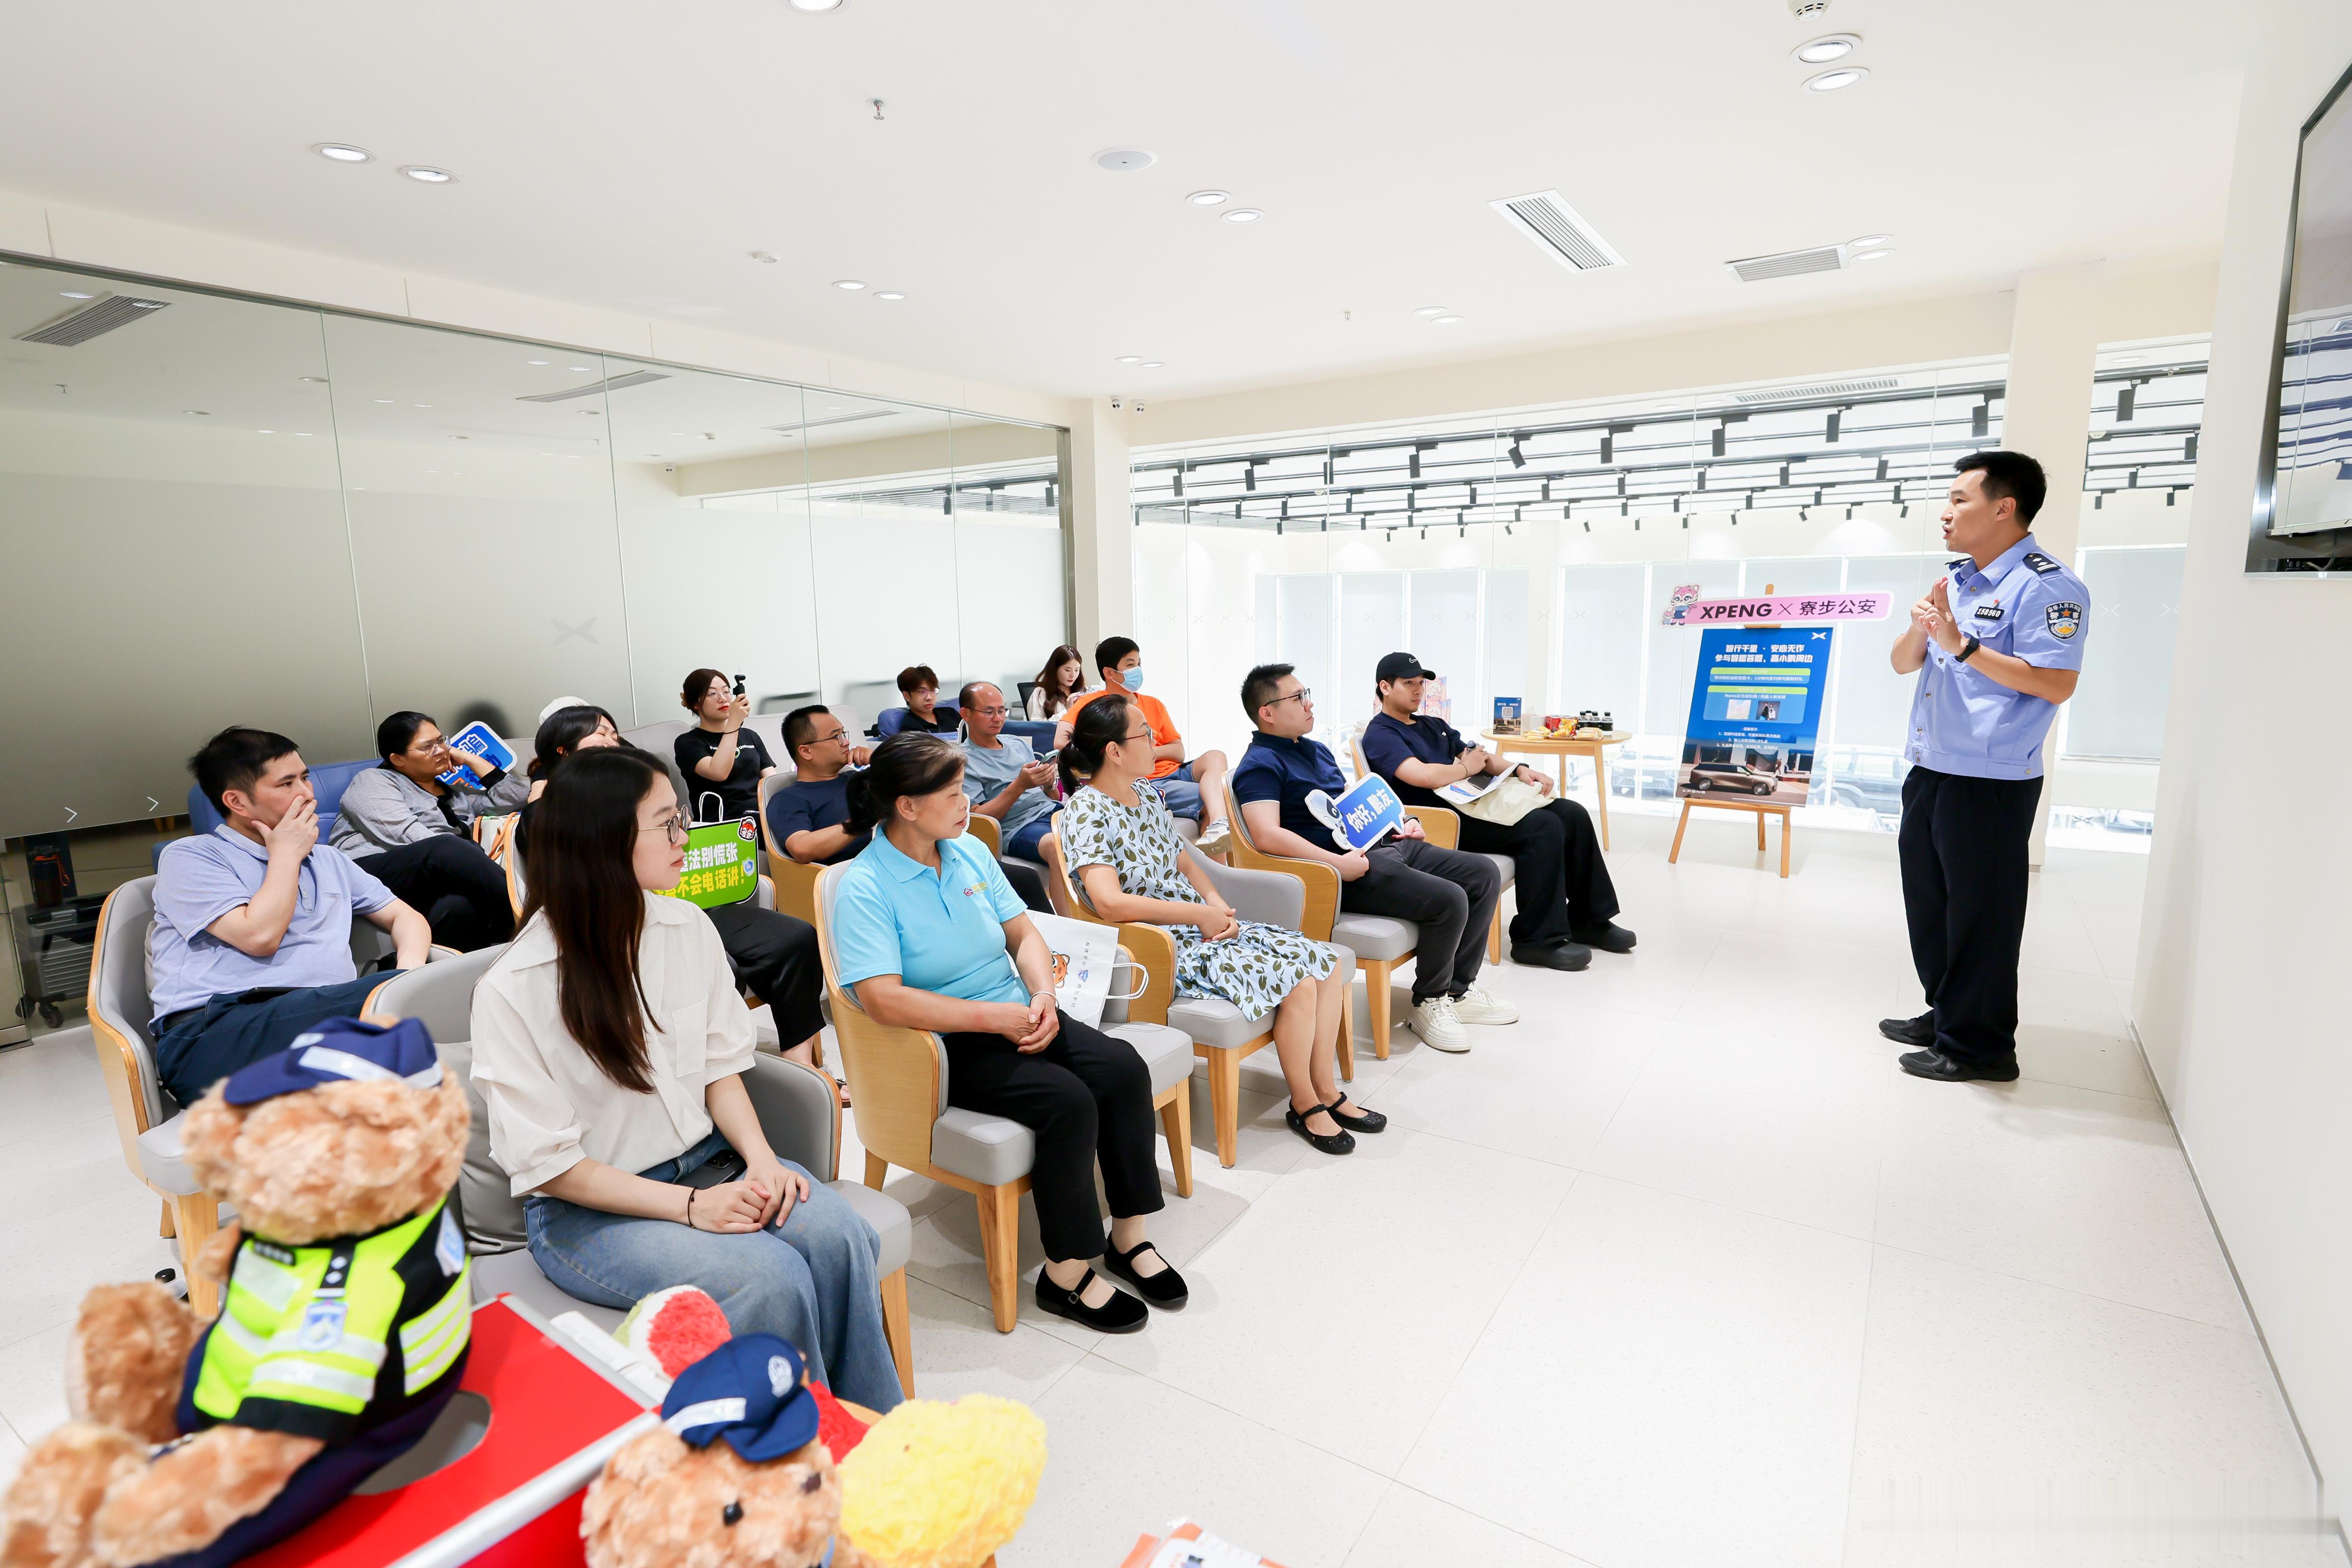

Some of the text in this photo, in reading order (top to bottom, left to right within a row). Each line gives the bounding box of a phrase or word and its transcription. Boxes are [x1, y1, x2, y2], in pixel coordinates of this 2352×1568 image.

[1700, 603, 1773, 619] XPENG
[1799, 599, 1877, 615] 寮步公安
[2047, 603, 2081, 612] 中华人民共和国
[1977, 608, 2001, 617] 158560
[1726, 644, 1758, 653] 智行千里
[1771, 644, 1805, 653] 安心无诈
[1346, 788, 1394, 833] 你好，鹏友
